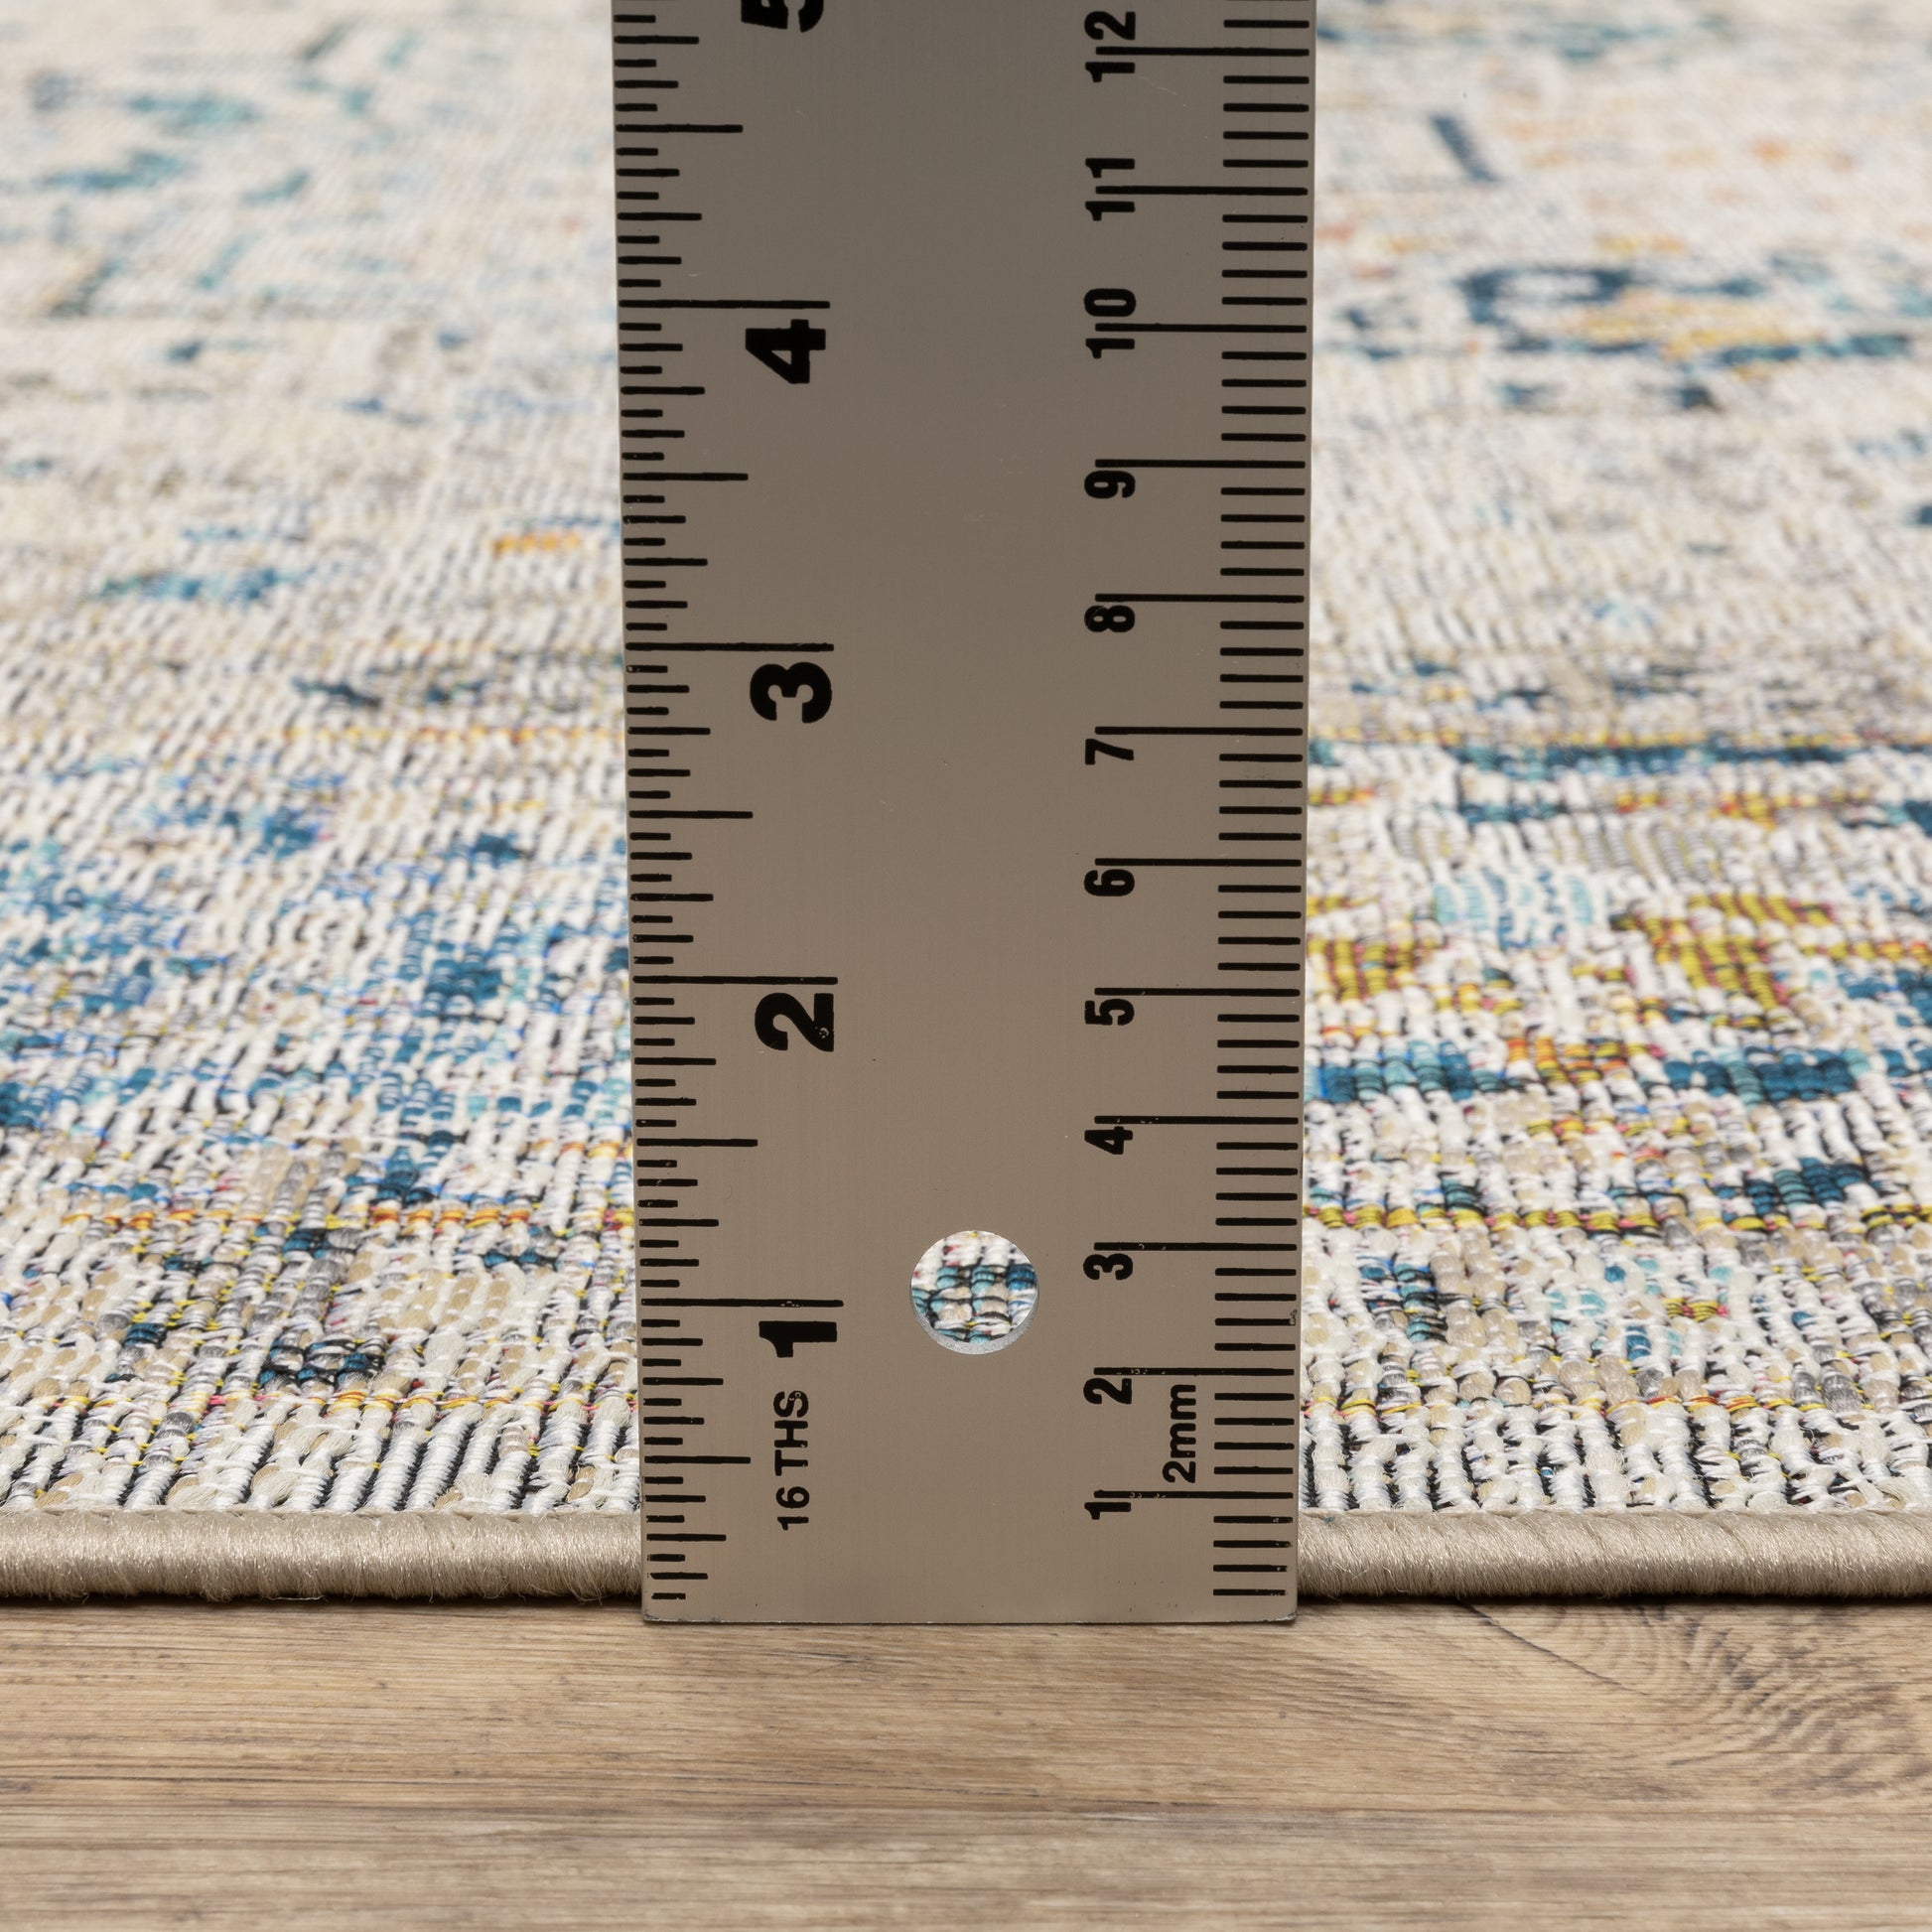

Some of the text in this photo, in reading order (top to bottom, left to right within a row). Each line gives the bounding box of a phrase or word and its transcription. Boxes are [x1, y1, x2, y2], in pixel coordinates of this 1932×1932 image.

[1083, 10, 1137, 83] 12
[1084, 157, 1137, 222] 11
[1082, 287, 1137, 359] 10
[744, 318, 827, 385] 4
[1083, 470, 1137, 499] 9
[1083, 604, 1136, 633] 8
[749, 661, 833, 724] 3
[1084, 738, 1135, 765] 7
[1083, 868, 1136, 897] 6
[754, 992, 835, 1052] 2
[1083, 998, 1136, 1027] 5
[1083, 1125, 1134, 1156] 4
[1082, 1252, 1134, 1281] 3
[758, 1319, 838, 1359] 1
[1082, 1377, 1133, 1405] 2
[1162, 1384, 1197, 1484] 2mm
[772, 1390, 810, 1531] 16 THS
[1083, 1501, 1132, 1521] 1
